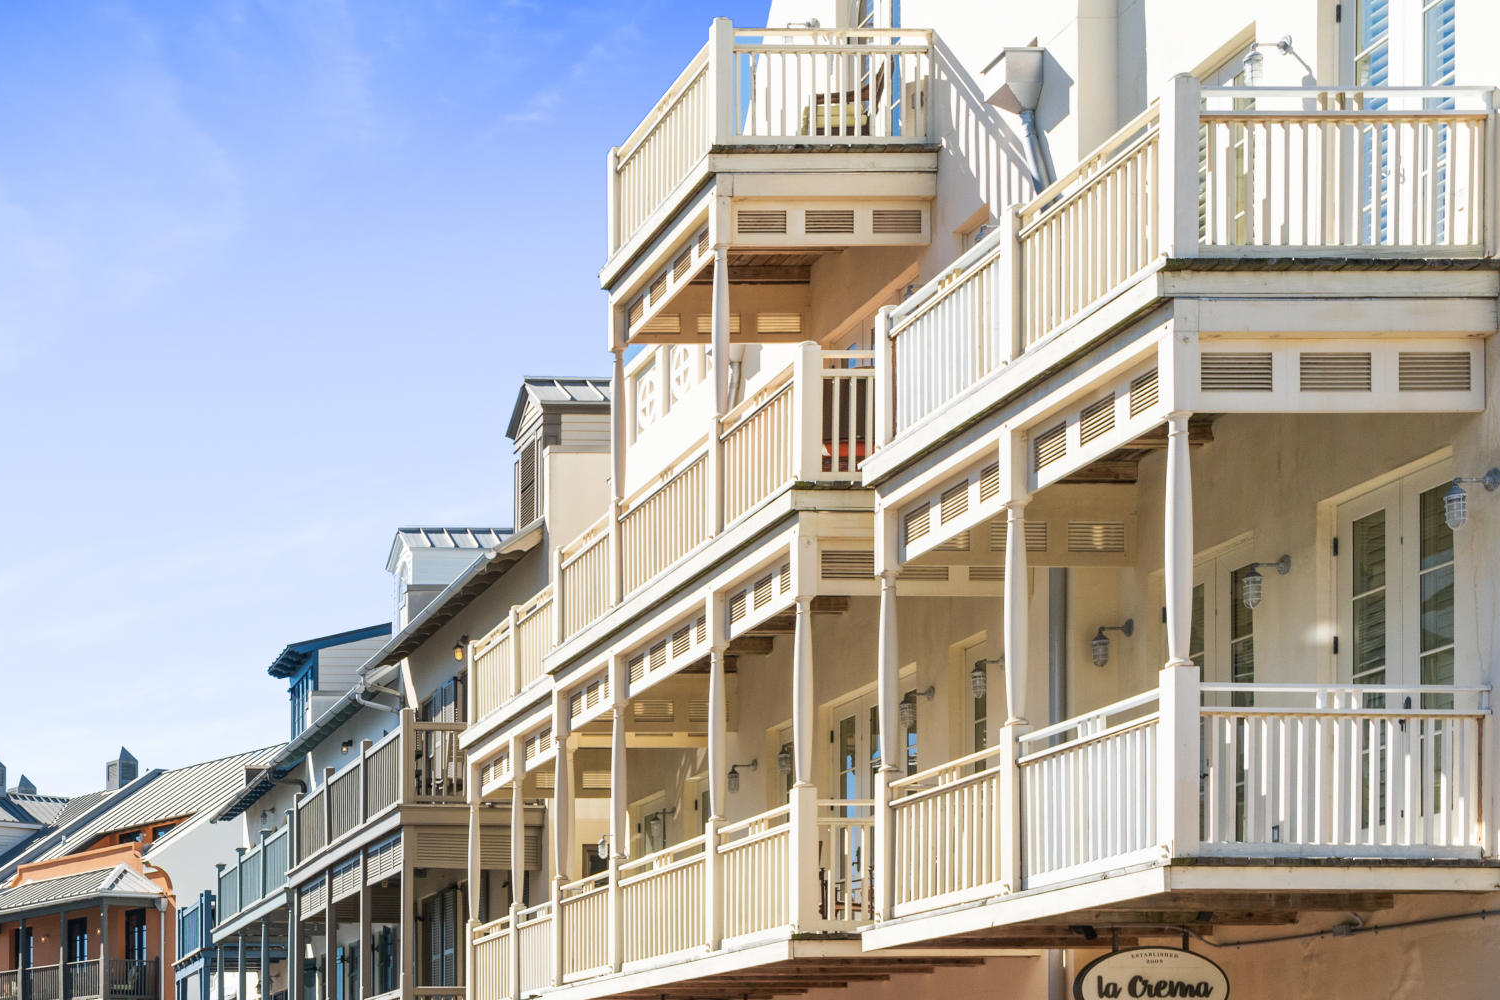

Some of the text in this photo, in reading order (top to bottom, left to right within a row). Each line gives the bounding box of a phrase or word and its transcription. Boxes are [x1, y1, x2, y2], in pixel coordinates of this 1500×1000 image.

[1131, 951, 1179, 959] ESTABLISHED
[1097, 975, 1214, 999] la Crema
